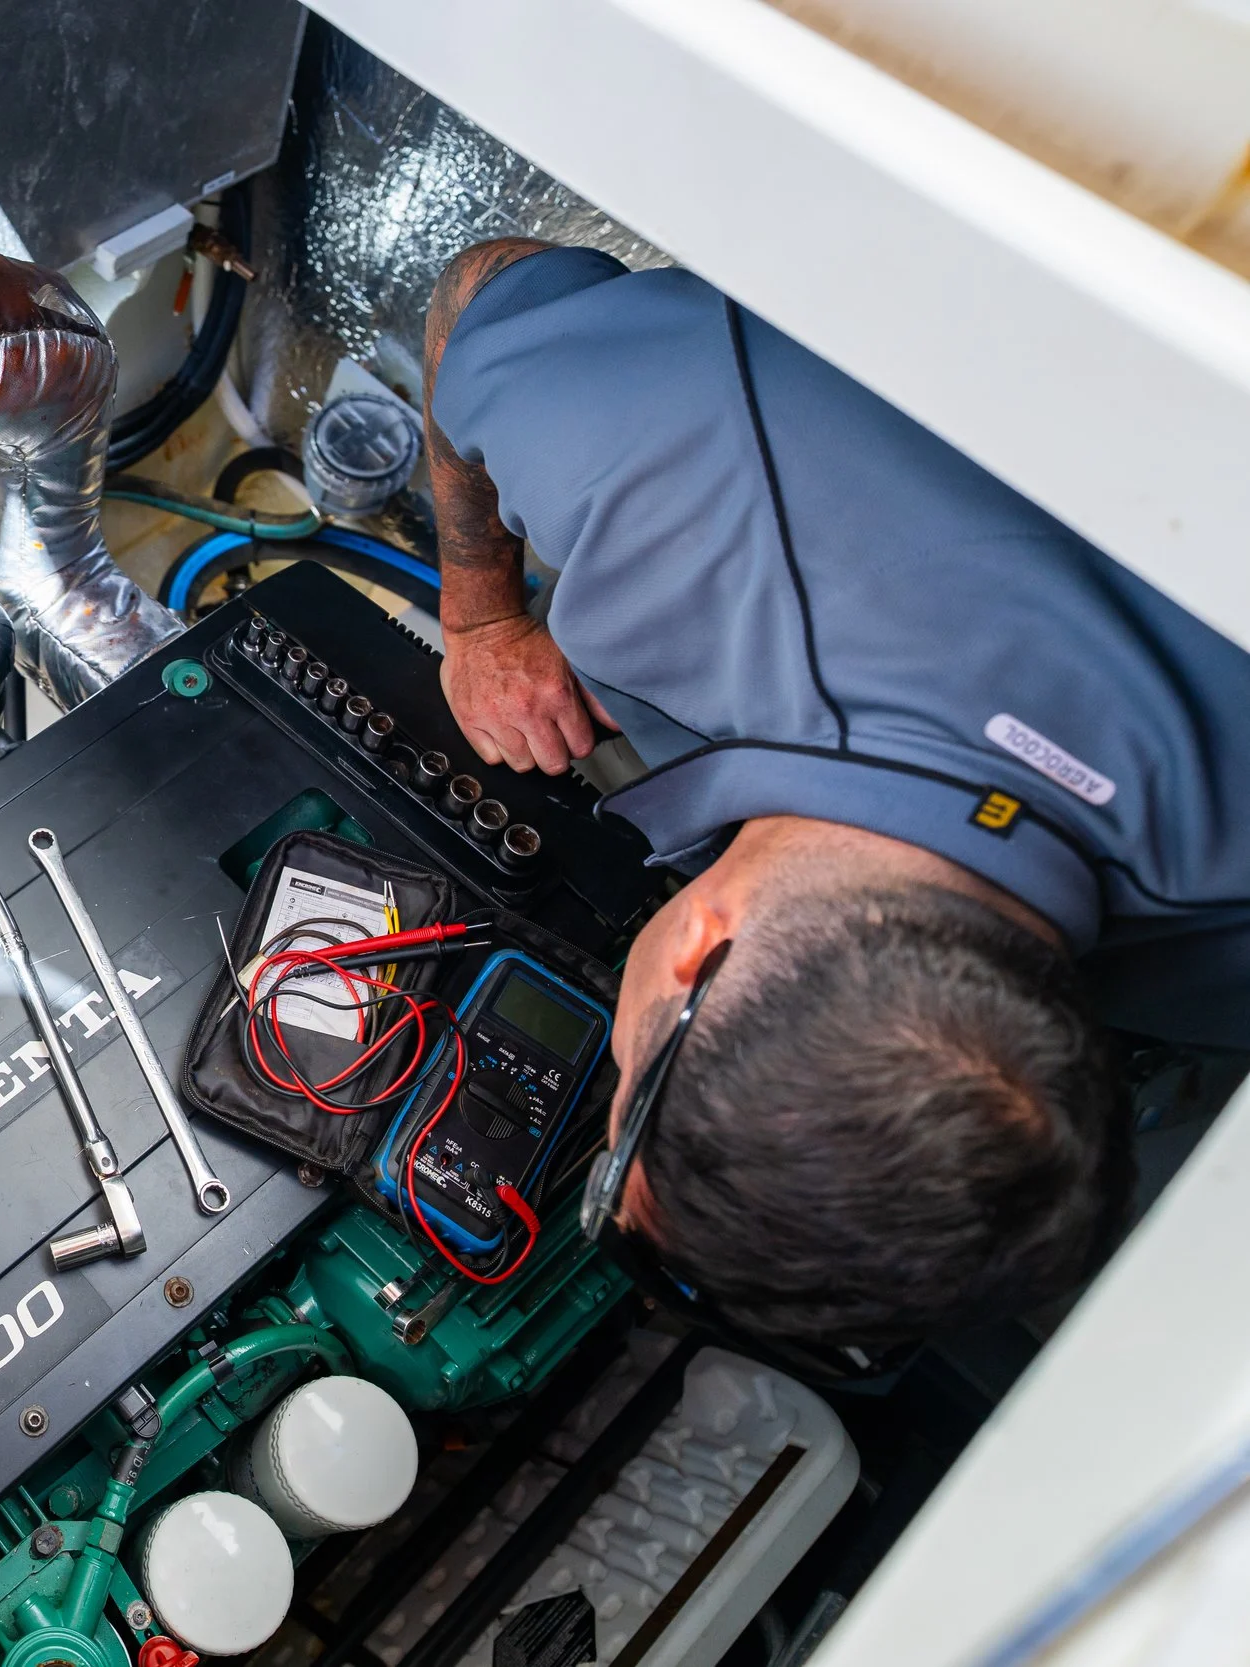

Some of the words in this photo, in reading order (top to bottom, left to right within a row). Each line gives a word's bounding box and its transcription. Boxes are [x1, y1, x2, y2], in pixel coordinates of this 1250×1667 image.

[475, 1031, 491, 1043] RANGE
[547, 1068, 562, 1081] CE
[464, 1195, 492, 1218] K8315
[131, 1454, 143, 1467] ID
